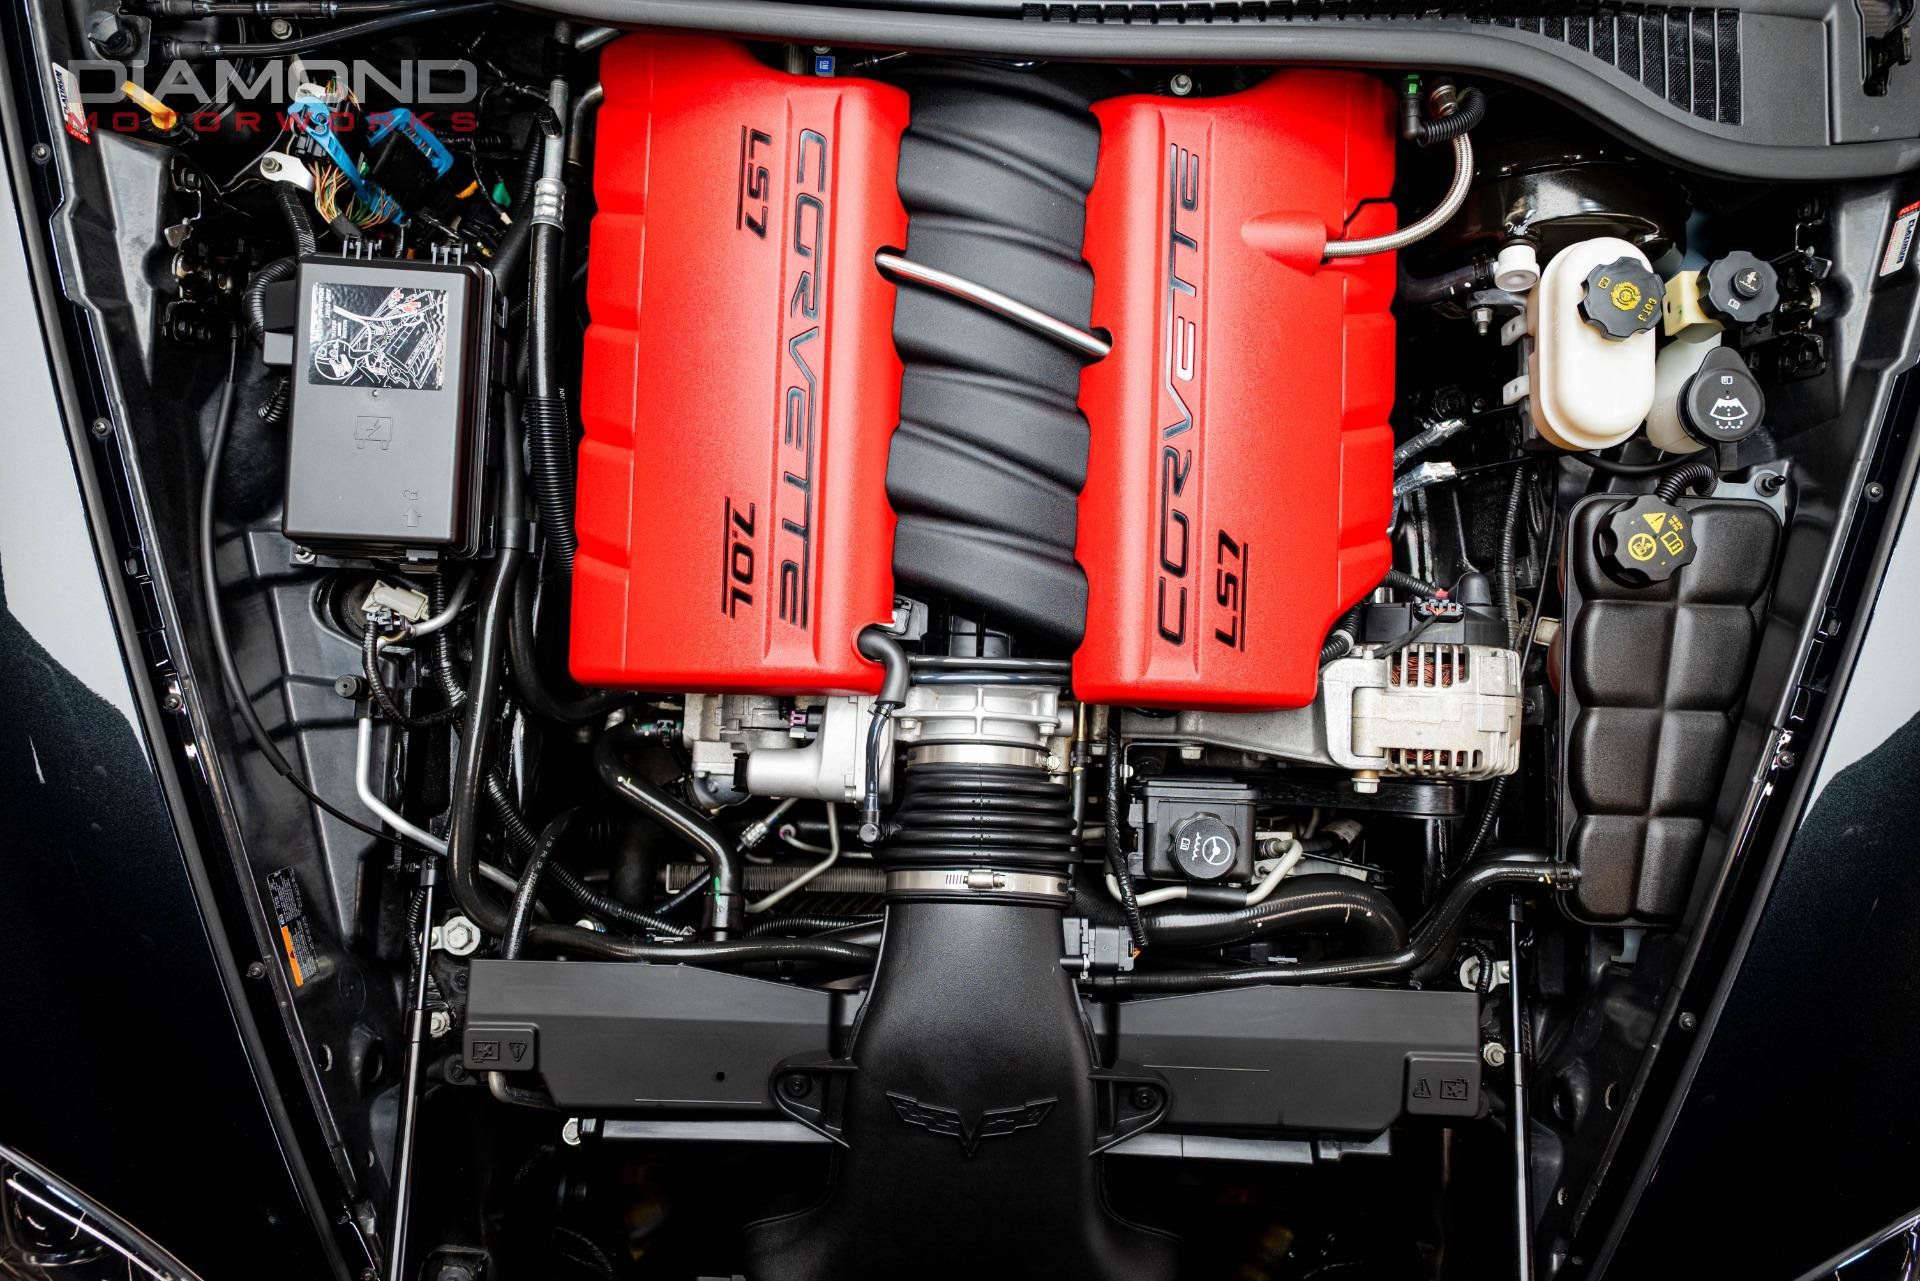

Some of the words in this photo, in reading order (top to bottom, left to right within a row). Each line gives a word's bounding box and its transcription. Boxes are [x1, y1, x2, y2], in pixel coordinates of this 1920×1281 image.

[745, 128, 772, 240] LS7
[1642, 297, 1657, 316] DOT
[779, 129, 828, 630] CORVETTE
[1158, 143, 1199, 646] CORVETTE
[730, 502, 756, 619] 7.0L
[1215, 530, 1241, 648] LS7
